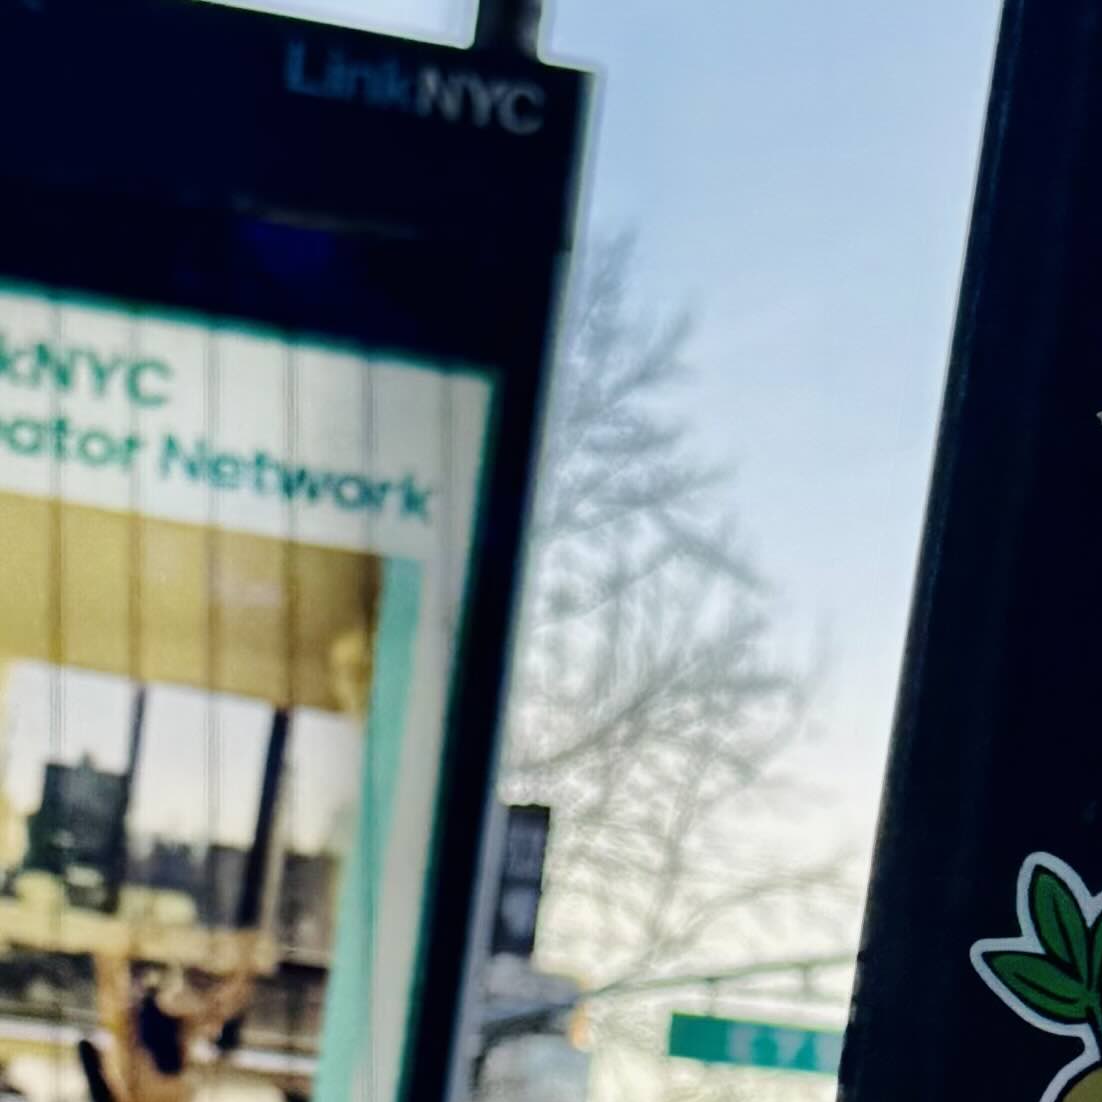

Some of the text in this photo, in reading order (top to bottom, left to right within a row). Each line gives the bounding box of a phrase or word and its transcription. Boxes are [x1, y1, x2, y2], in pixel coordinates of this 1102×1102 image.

[284, 39, 546, 135] LinkNYC
[0, 412, 433, 521] ator Network
